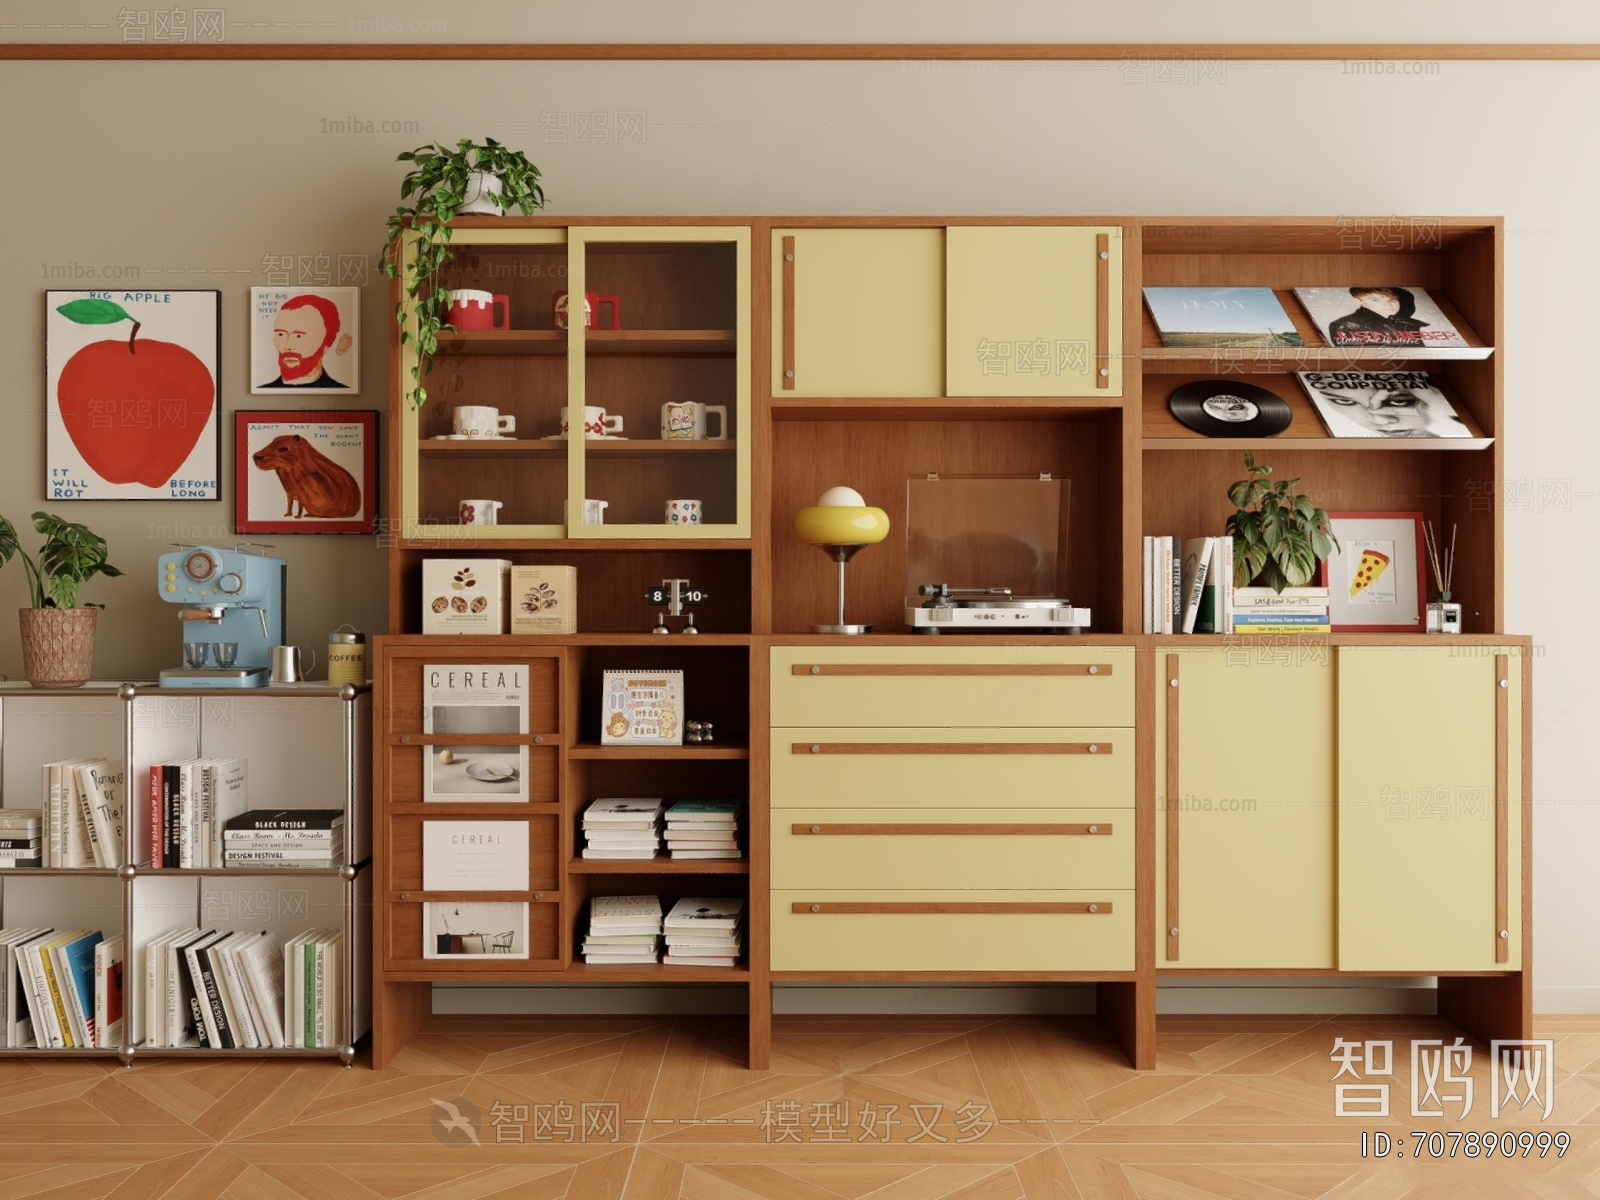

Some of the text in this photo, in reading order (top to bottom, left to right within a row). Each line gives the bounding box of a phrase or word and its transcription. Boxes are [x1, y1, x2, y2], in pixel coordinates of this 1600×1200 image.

[89, 291, 171, 303] BIG APPLE
[1304, 372, 1427, 382] G-DRAGON
[53, 468, 69, 477] IT
[52, 479, 89, 488] WILL
[169, 479, 216, 488] BEFORE
[54, 488, 84, 497] ROT
[171, 489, 206, 497] LONG
[1173, 558, 1181, 615] BETTER DESIGN
[653, 590, 663, 602] 8
[685, 590, 702, 602] 10
[329, 654, 364, 662] COFFEE
[430, 671, 522, 688] CEREAL
[451, 834, 502, 845] CEREAL
[228, 852, 283, 860] DESIGN FESTIVAL
[203, 970, 217, 1001] BETTER
[211, 998, 226, 1030] DESIGN
[190, 997, 207, 1042] TOM FORD
